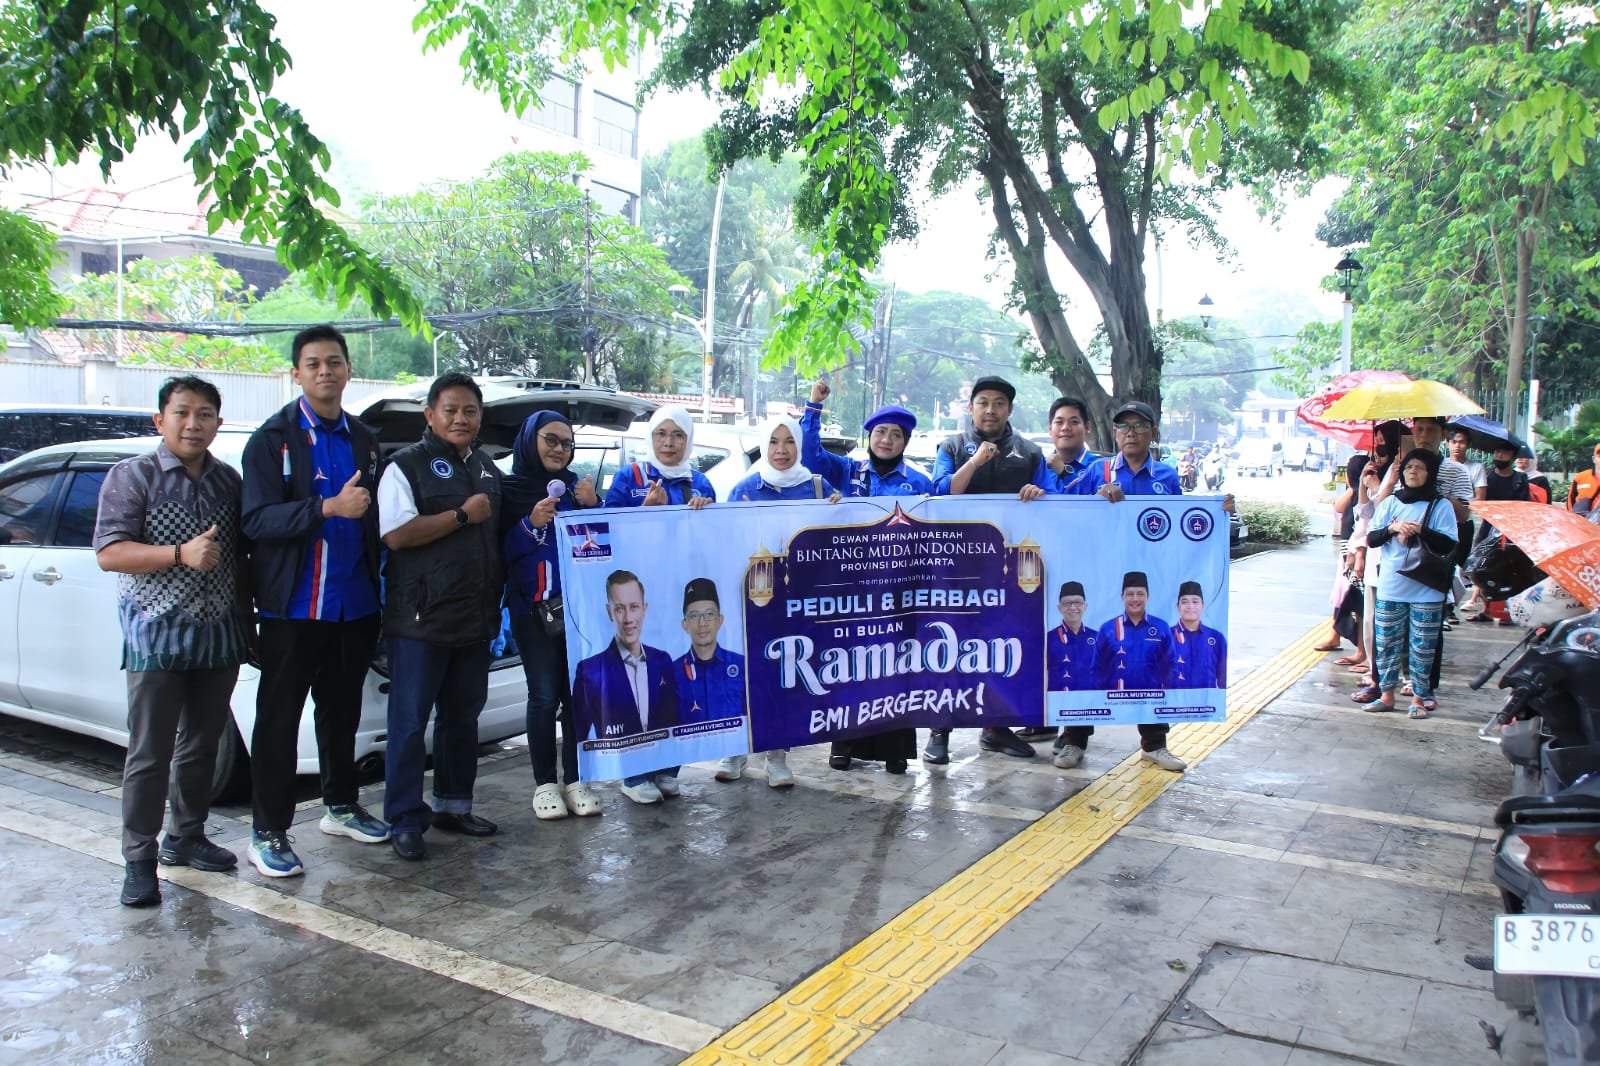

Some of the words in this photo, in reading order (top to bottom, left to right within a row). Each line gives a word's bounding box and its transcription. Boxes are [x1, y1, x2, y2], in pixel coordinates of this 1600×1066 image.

[832, 534, 869, 544] DEWAN
[871, 531, 919, 541] PIMPINAN
[920, 531, 963, 539] DAERAH
[796, 546, 864, 562] BINTANG
[868, 544, 911, 558] MUDA
[914, 542, 997, 555] INDONESIA
[840, 561, 889, 572] PROVINSI
[891, 560, 907, 568] DKI
[909, 558, 955, 567] JAKARTA
[786, 594, 873, 617] PEDULI
[881, 592, 895, 611] &
[902, 588, 1006, 609] BERBAGI
[834, 627, 850, 638] DI
[857, 621, 904, 637] BULAN
[764, 621, 1022, 696] Ramadan
[809, 706, 850, 734] BMI
[857, 682, 985, 726] BERGERAK!
[605, 723, 624, 735] AHY
[1504, 920, 1517, 943] B
[1531, 920, 1594, 943] 3876
